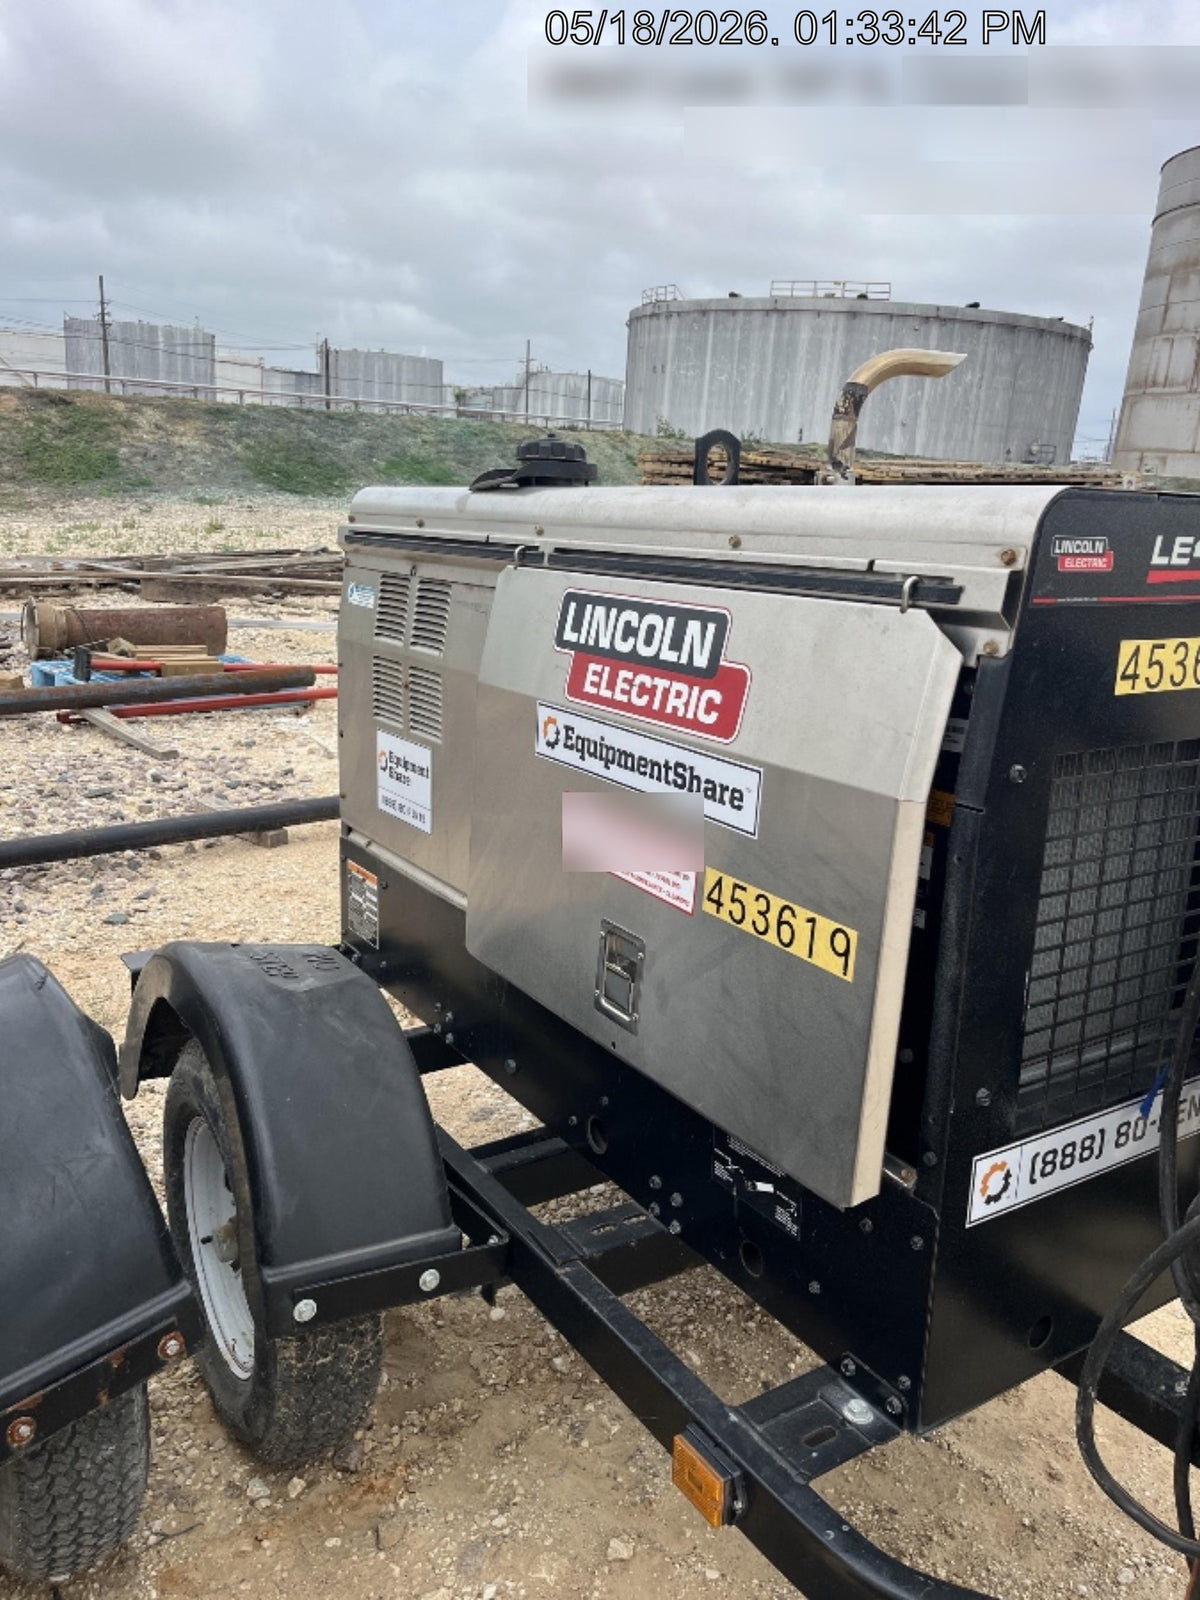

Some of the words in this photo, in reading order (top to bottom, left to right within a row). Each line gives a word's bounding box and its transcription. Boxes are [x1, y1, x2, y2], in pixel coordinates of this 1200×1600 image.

[1054, 539, 1106, 555] LINCOLN
[1064, 556, 1108, 569] ELECTRIC
[1150, 534, 1200, 565] LE
[562, 600, 719, 670] LINCOLN
[582, 662, 724, 726] ELECTRIC
[563, 725, 746, 812] EquipmentShare
[706, 875, 853, 977] 453619
[1028, 1128, 1106, 1185] (888)
